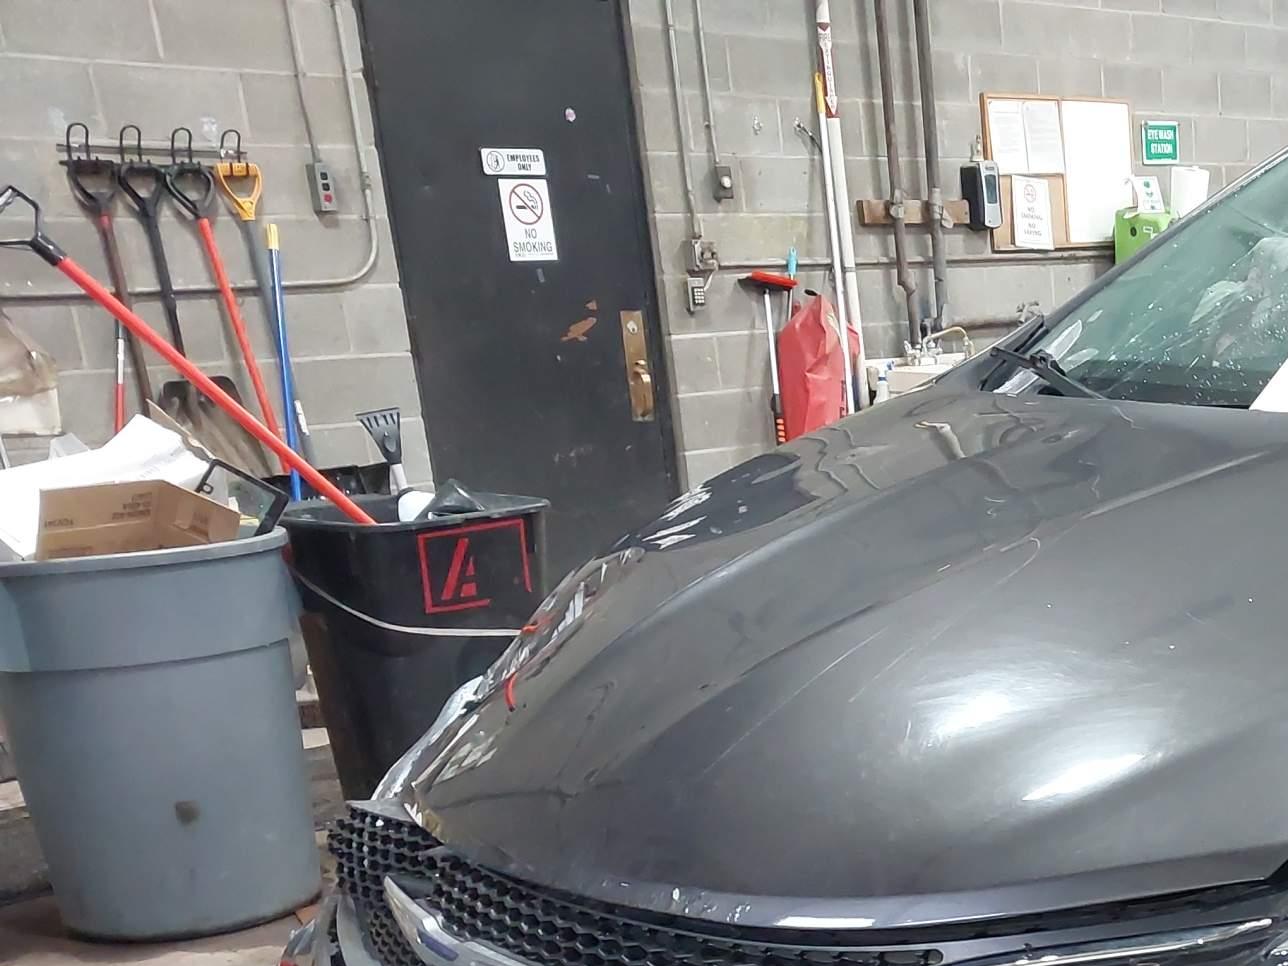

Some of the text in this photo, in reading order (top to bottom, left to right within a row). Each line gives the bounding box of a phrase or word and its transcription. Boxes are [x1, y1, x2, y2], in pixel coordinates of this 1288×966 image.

[1151, 143, 1173, 154] STATION
[507, 154, 540, 162] EMPLOYEES
[517, 163, 532, 172] ONLY
[524, 228, 537, 239] NO
[512, 241, 553, 253] SMOKING
